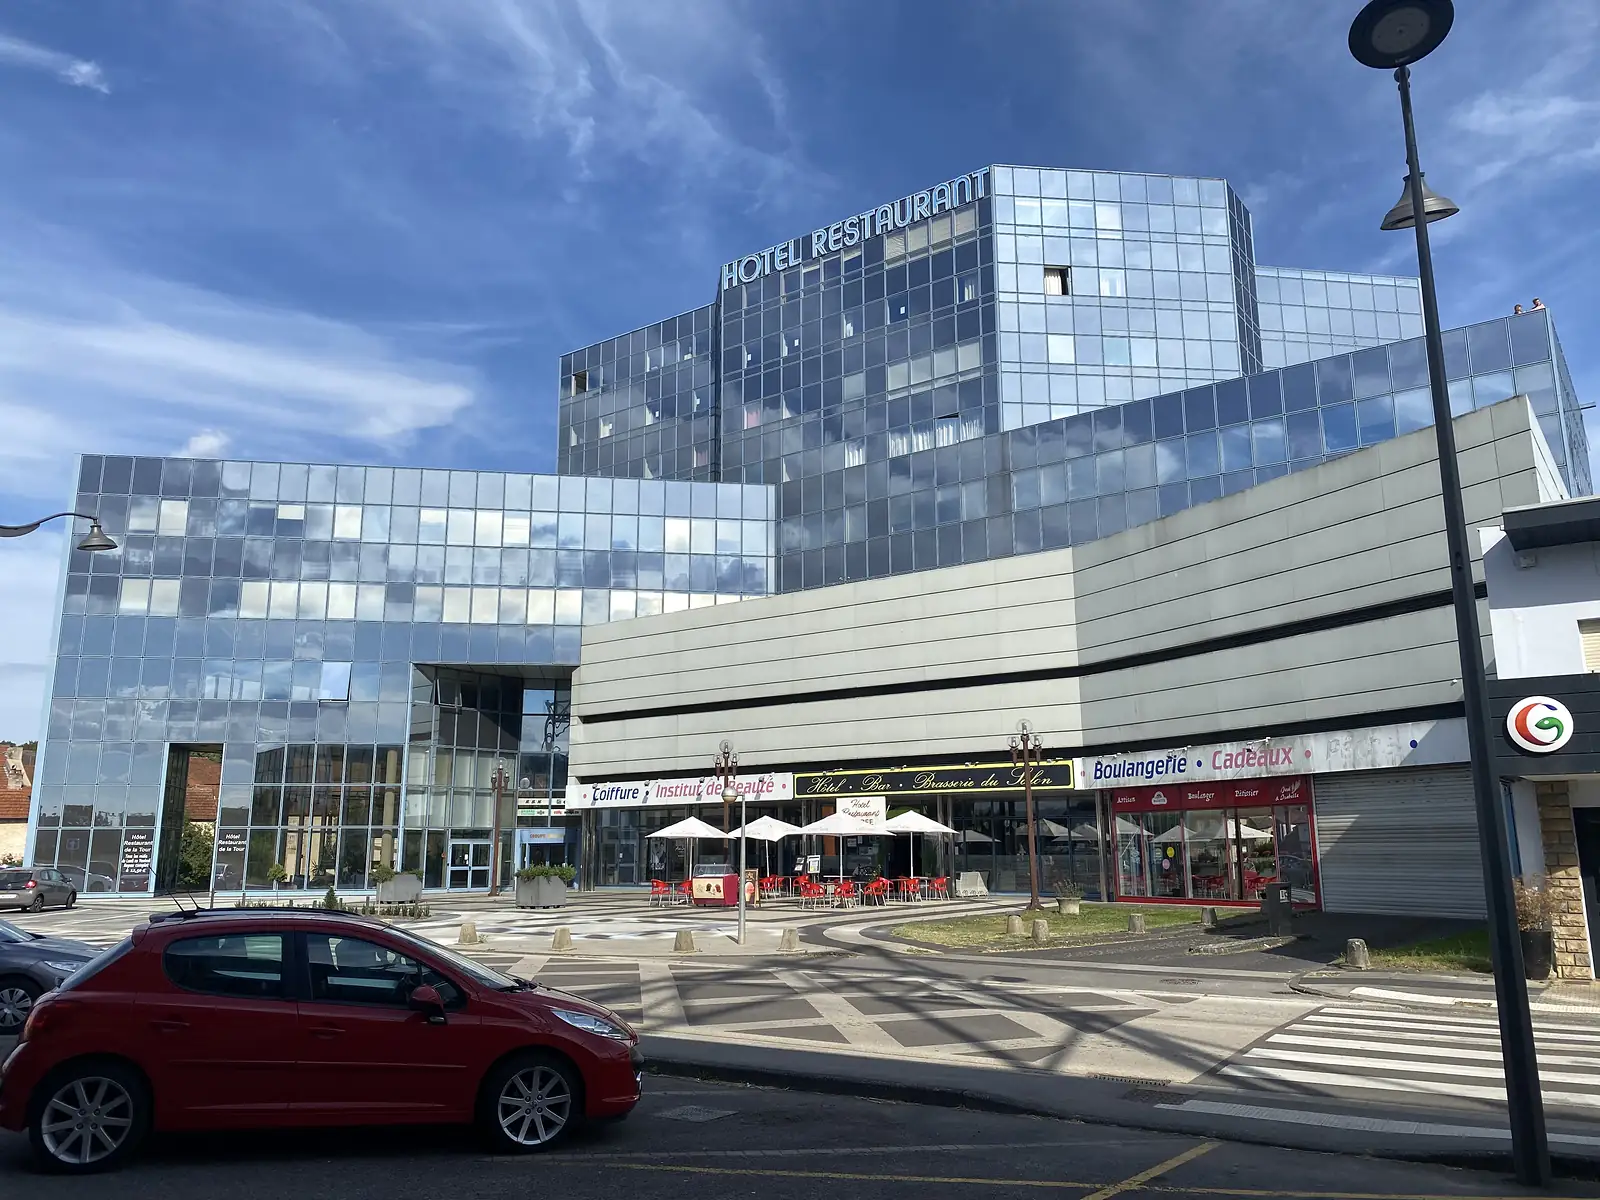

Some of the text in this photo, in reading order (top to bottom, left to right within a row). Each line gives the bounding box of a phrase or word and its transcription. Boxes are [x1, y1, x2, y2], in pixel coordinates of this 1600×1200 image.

[722, 167, 990, 290] HOTEL RESTAURANT
[1093, 755, 1187, 779] Boulangerie
[1211, 746, 1293, 770] Cadeaux
[592, 786, 639, 801] Coiffure
[655, 782, 701, 798] Institut
[706, 781, 722, 795] de
[806, 776, 847, 794] Hôtel
[861, 774, 892, 792] Bar
[912, 771, 975, 789] Brasserie
[980, 773, 999, 787] du
